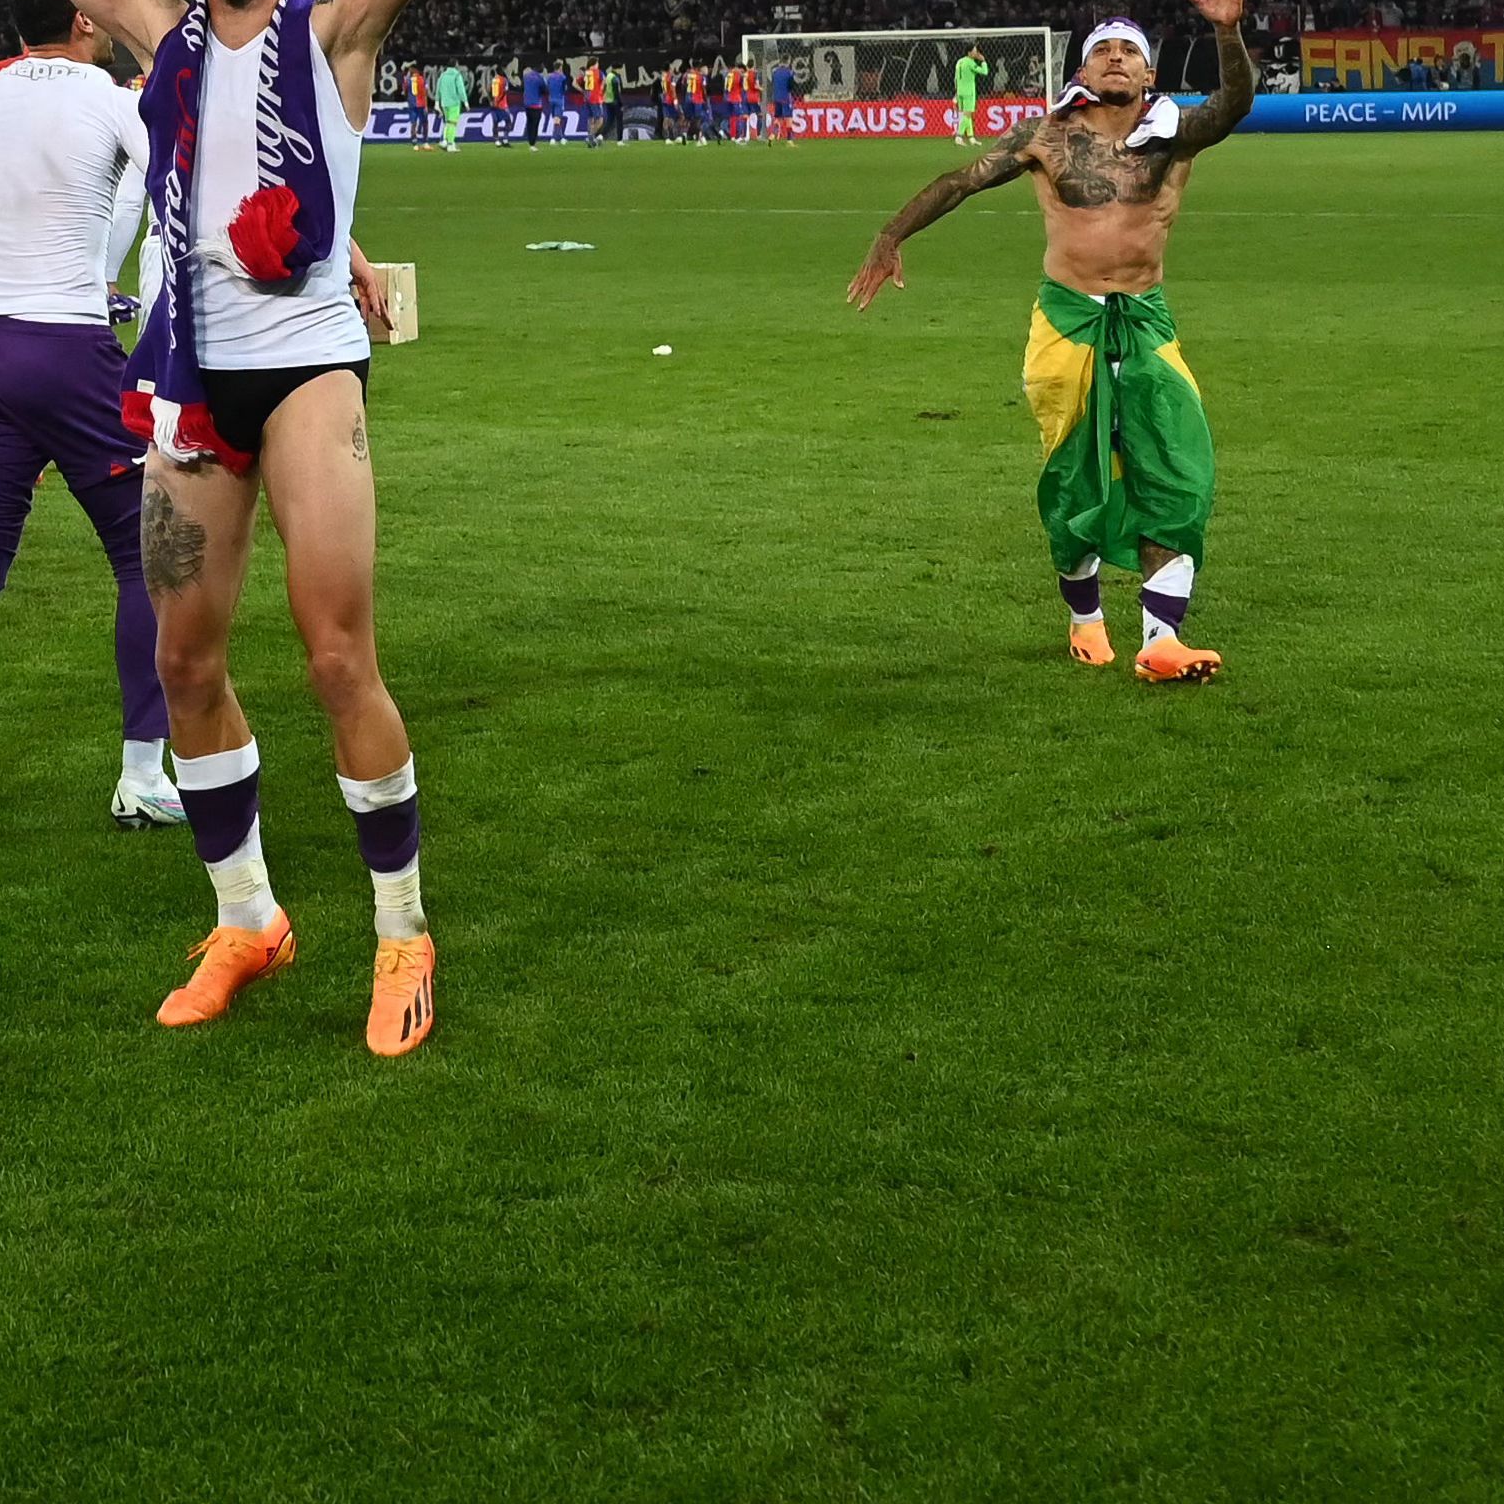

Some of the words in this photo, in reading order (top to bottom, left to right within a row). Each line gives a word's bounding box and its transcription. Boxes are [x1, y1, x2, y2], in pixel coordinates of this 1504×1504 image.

[791, 108, 926, 133] STRAUSS
[1305, 102, 1377, 123] PEACE
[1402, 101, 1457, 123] МИР
